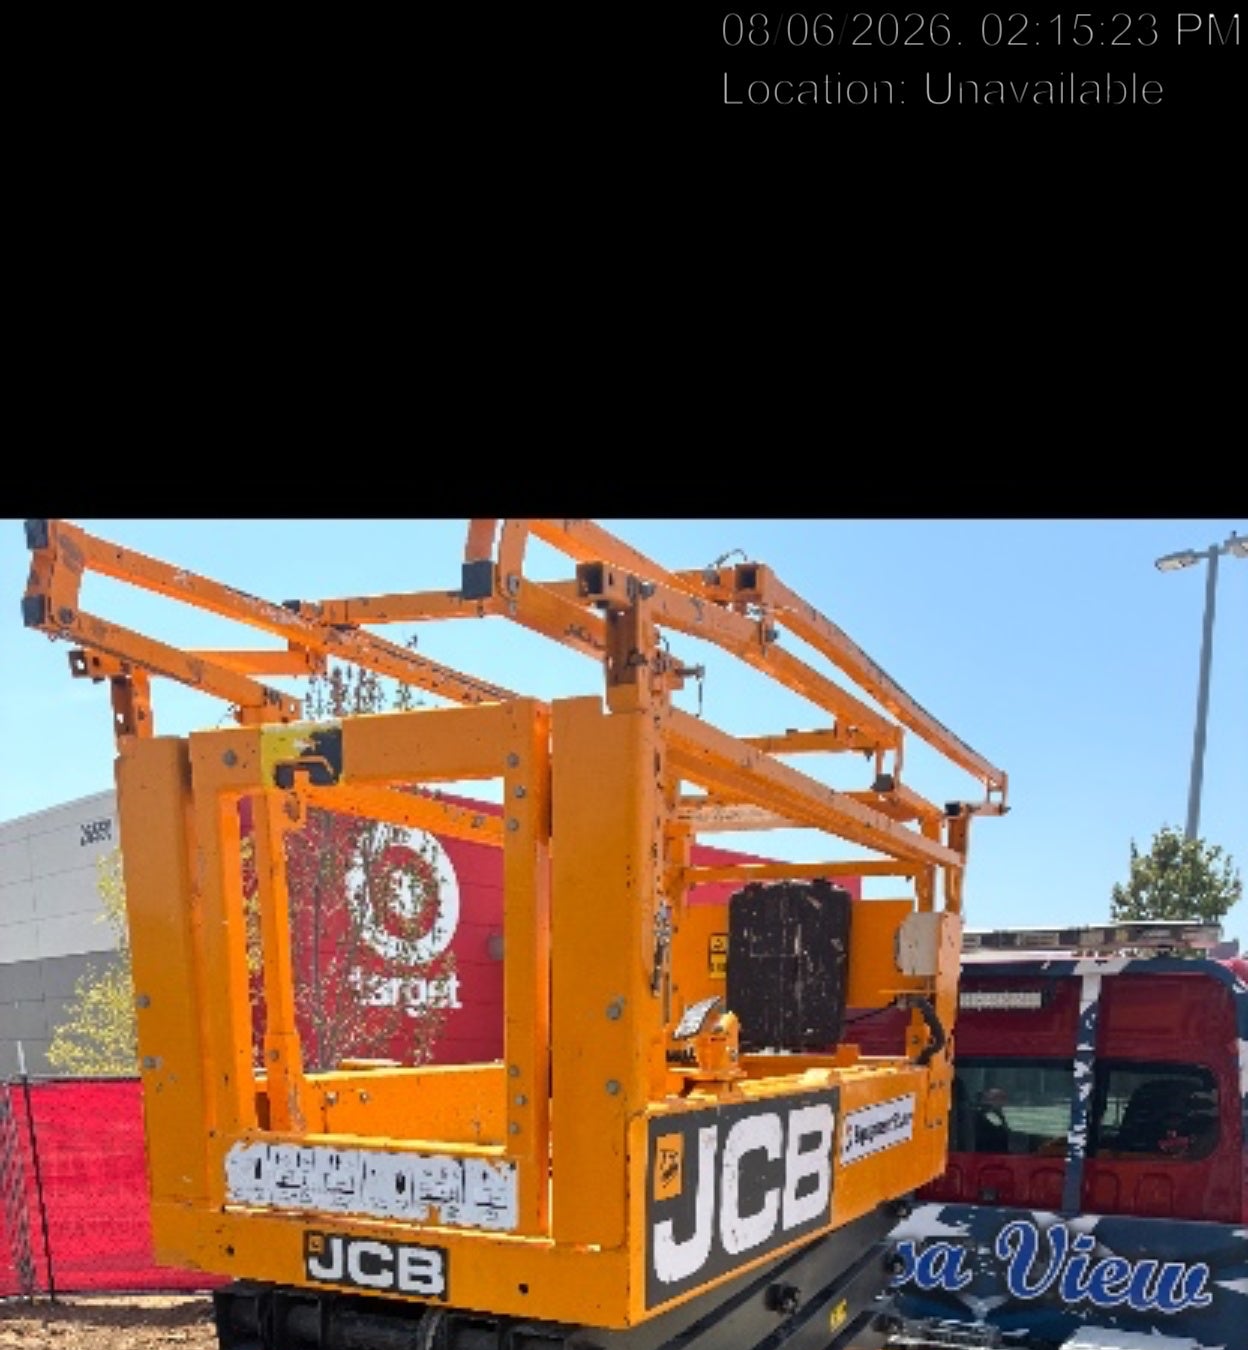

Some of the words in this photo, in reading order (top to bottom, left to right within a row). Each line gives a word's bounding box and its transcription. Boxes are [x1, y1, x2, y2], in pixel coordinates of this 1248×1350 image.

[654, 1103, 835, 1284] JCB
[308, 1237, 445, 1294] JCB
[995, 1220, 1213, 1314] View
